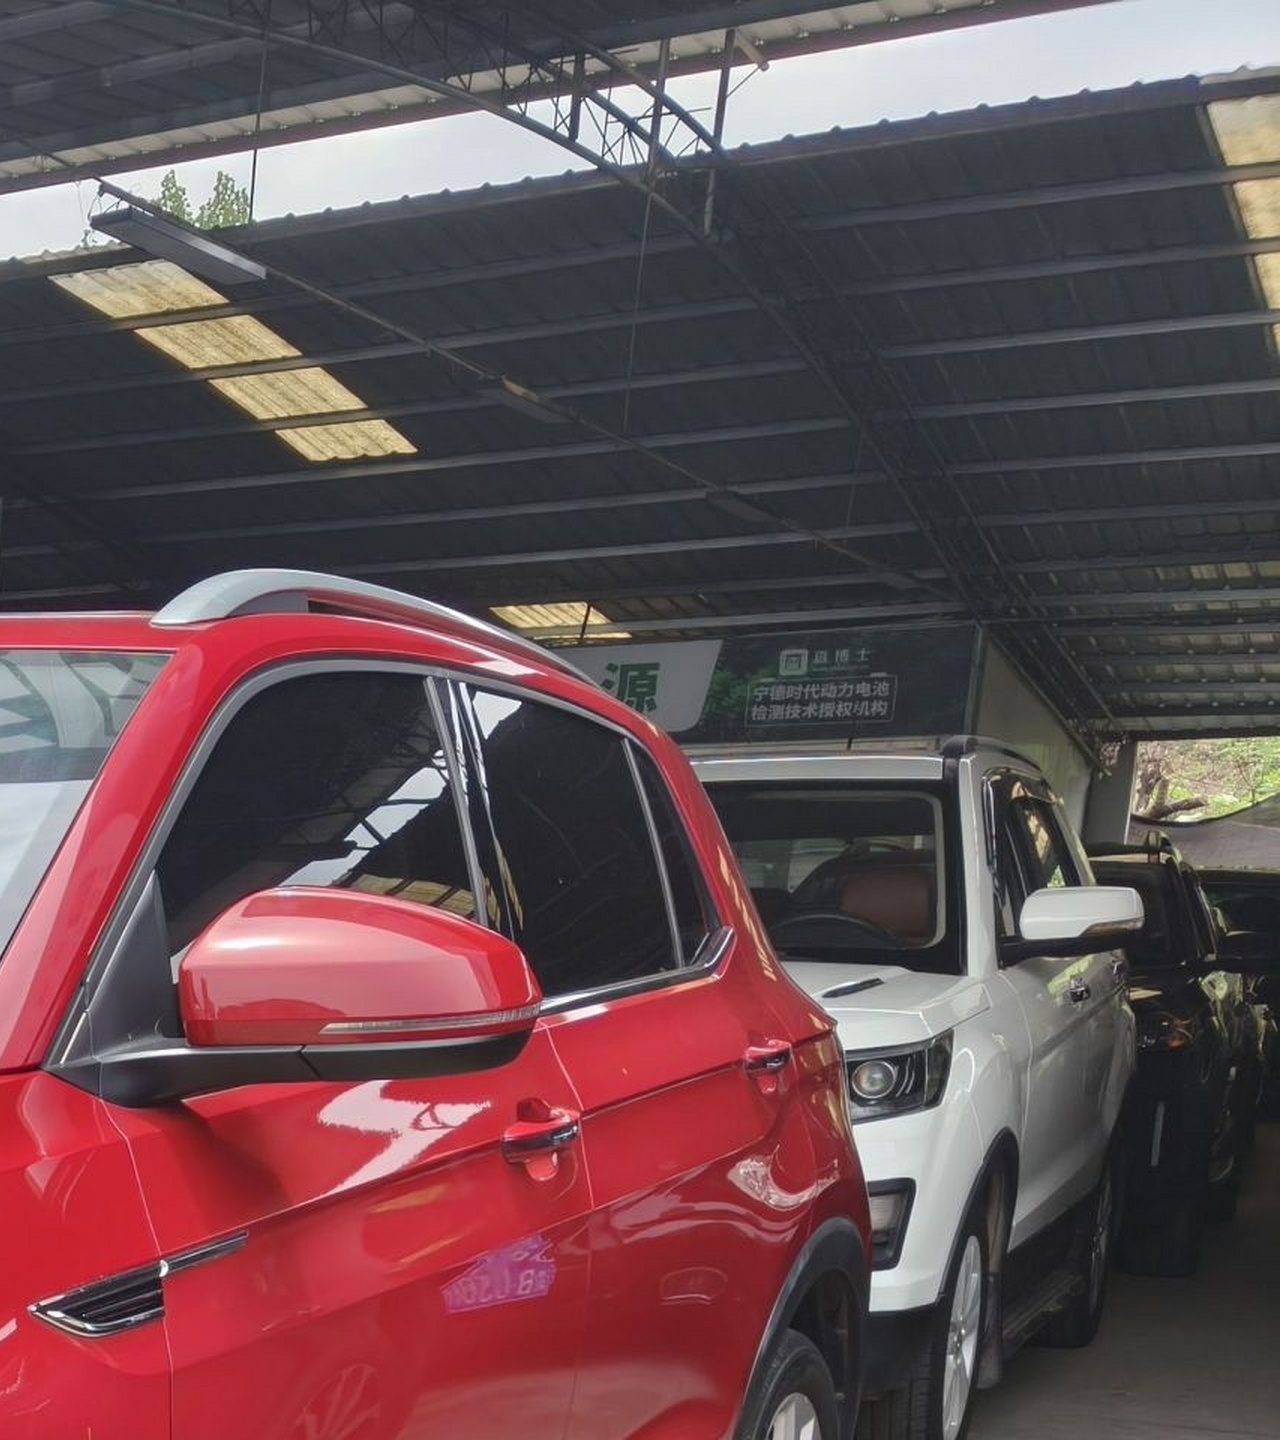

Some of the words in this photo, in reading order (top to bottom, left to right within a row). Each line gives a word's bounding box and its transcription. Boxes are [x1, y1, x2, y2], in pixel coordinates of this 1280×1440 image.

[601, 662, 660, 712] 源
[752, 680, 890, 702] 宁德时代动力电池
[751, 699, 889, 721] 检测技术授权机构
